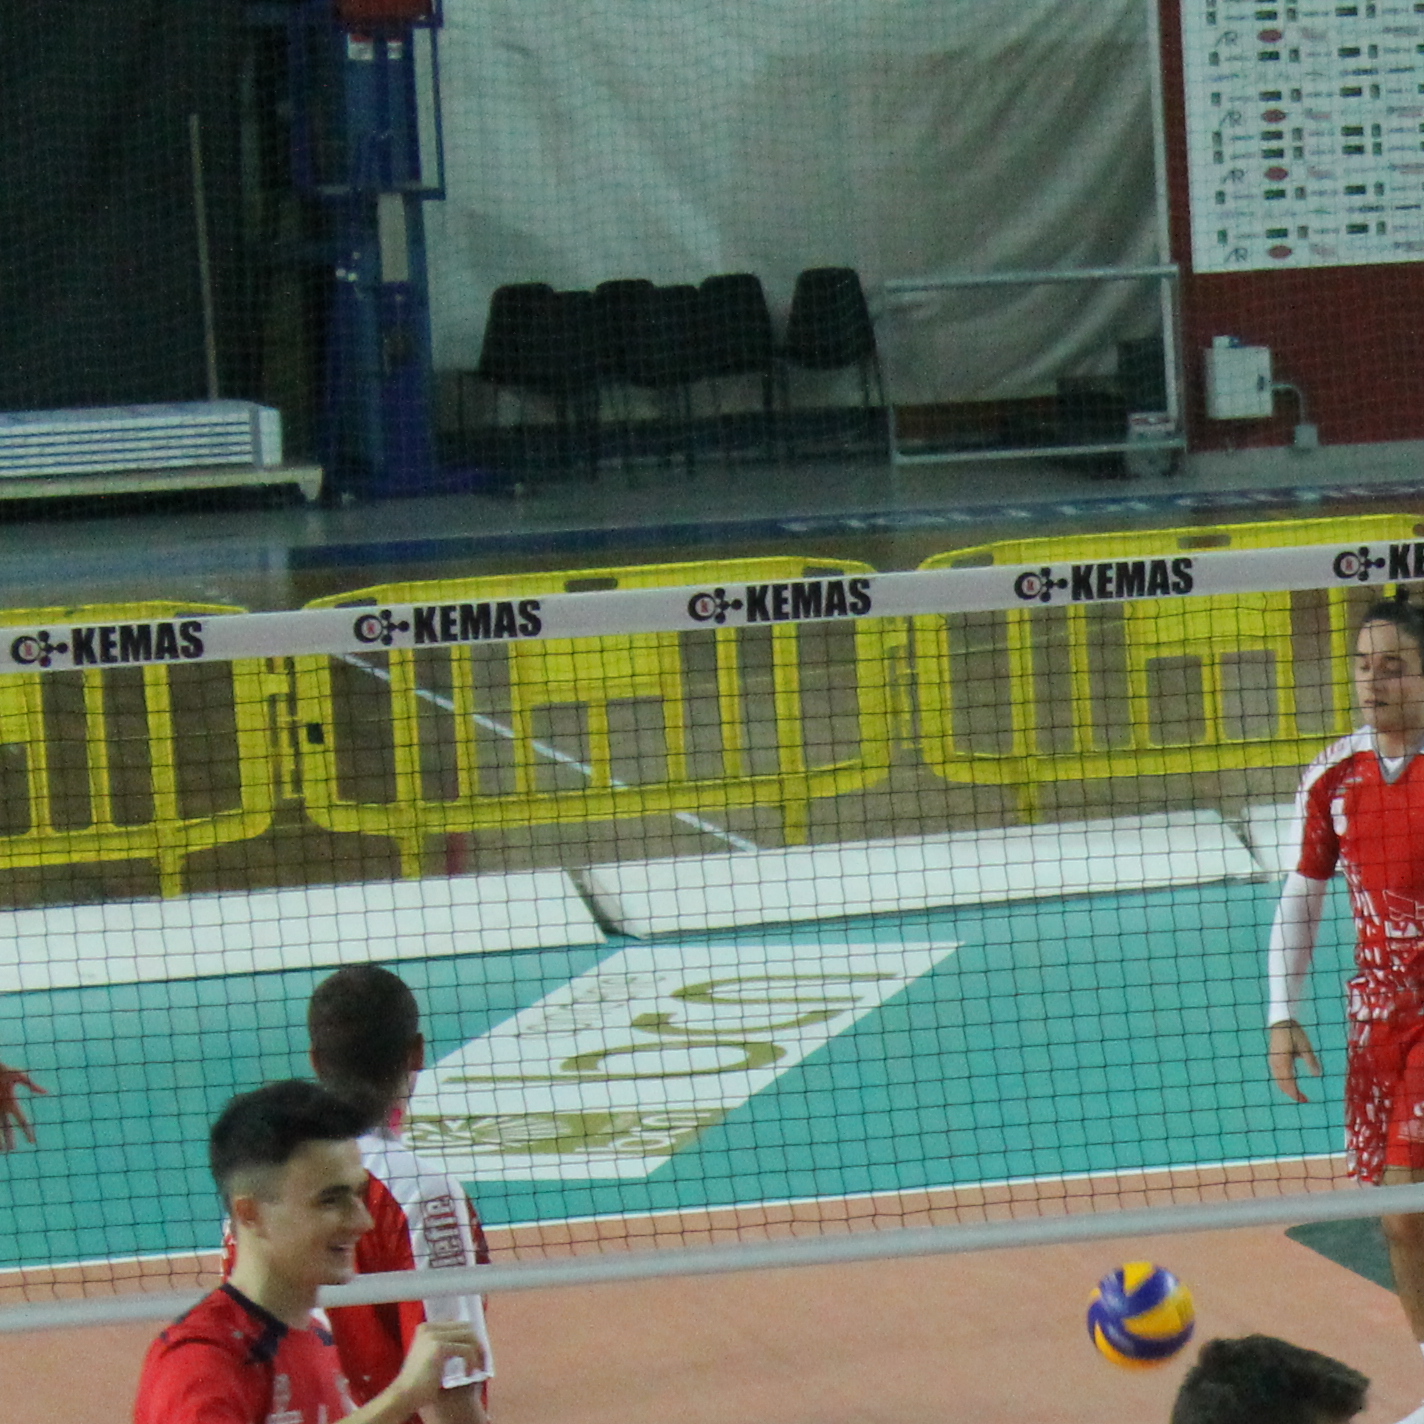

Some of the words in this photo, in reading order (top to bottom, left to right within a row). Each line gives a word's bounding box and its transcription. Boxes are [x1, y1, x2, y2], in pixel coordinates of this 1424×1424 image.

[1071, 558, 1193, 599] KEMAS
[747, 579, 871, 622] KEMAS
[73, 622, 204, 665] KEMAS
[414, 601, 541, 644] KEMAS
